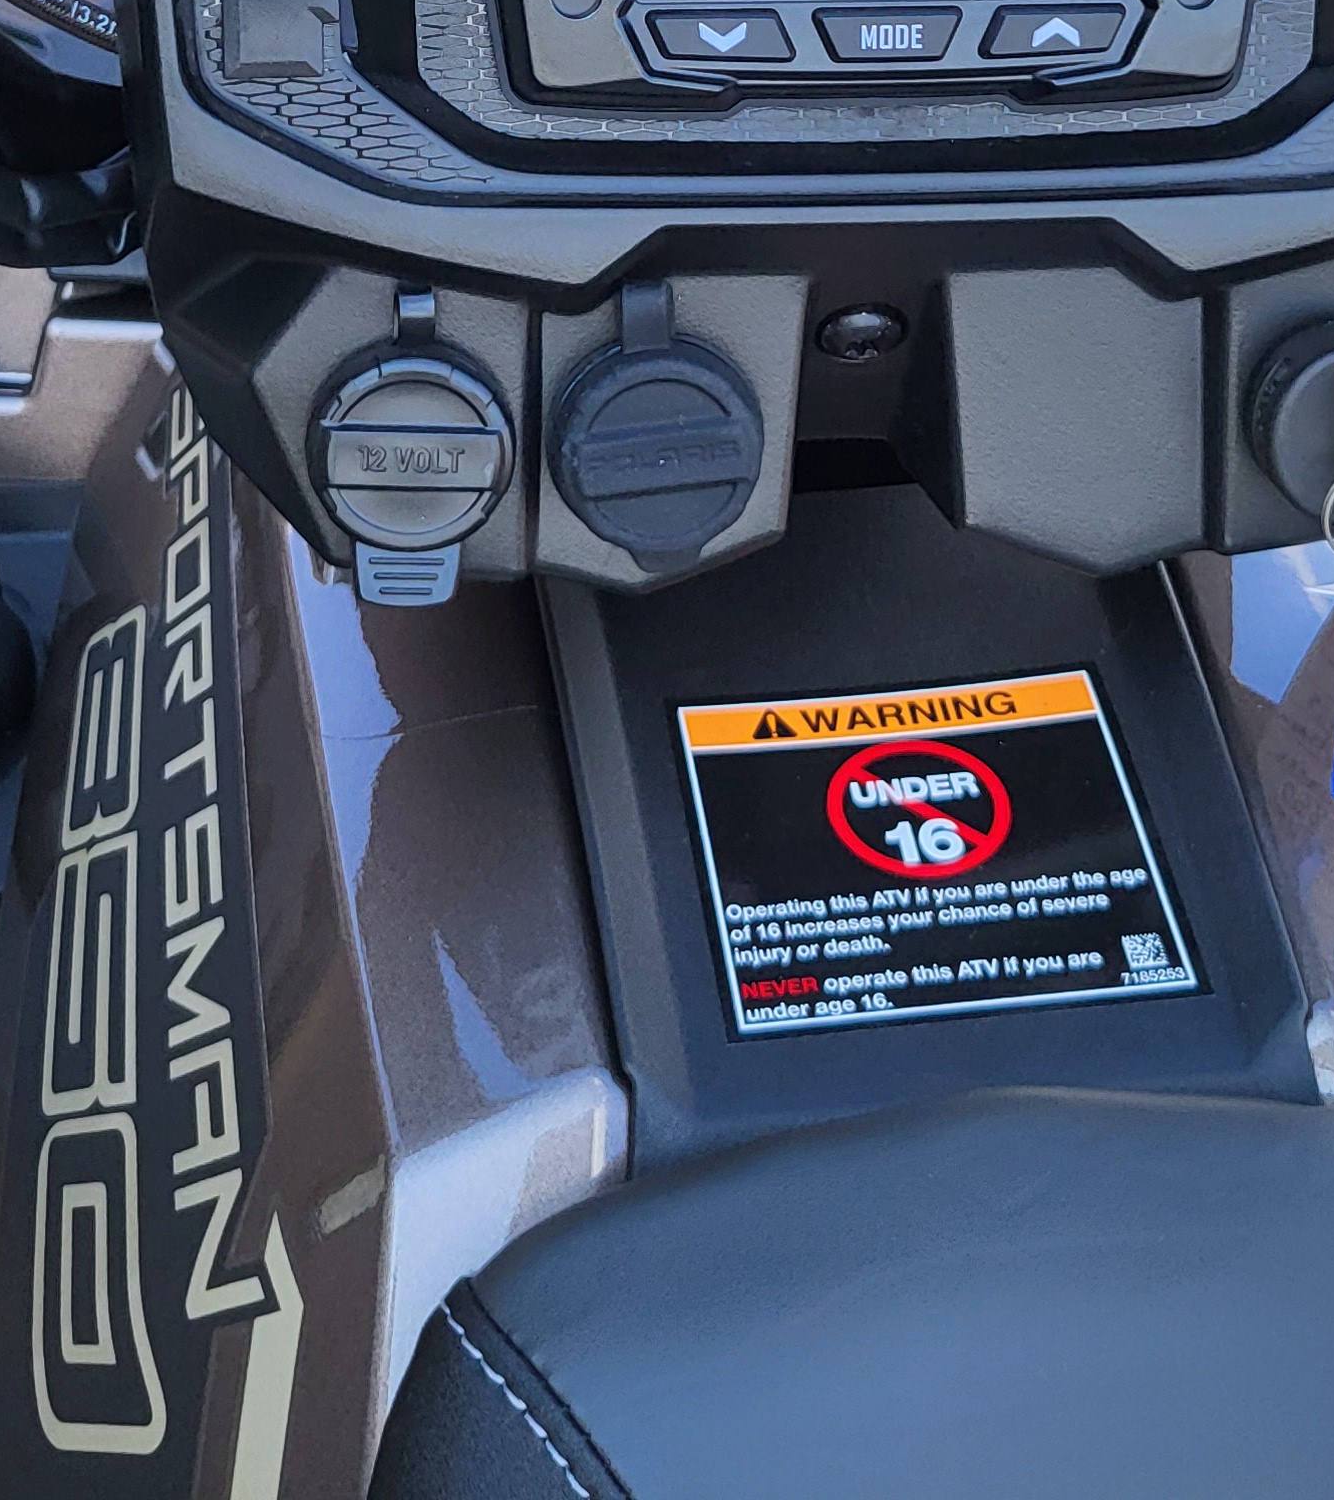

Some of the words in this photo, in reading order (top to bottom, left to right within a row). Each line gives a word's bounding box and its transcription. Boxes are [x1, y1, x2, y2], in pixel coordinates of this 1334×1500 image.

[861, 24, 924, 50] MODE
[357, 444, 387, 474] 12
[394, 446, 466, 475] VOLT
[799, 690, 1017, 733] WARNING
[849, 771, 981, 809] UNDER
[163, 387, 266, 1321] SPORTSMAN
[884, 817, 967, 867] 16
[725, 898, 827, 924] Operating
[829, 893, 869, 913] this
[872, 888, 911, 911] ATV
[914, 886, 930, 906] if
[932, 884, 971, 906] you
[974, 881, 1008, 901] are
[1010, 874, 1069, 897] under
[1072, 870, 1107, 891] the
[1109, 867, 1149, 891] age
[730, 924, 752, 945] of
[756, 921, 782, 944] 16
[784, 913, 886, 941] increases
[887, 909, 934, 935] your
[938, 901, 1014, 926] chance
[1016, 897, 1039, 918] of
[1041, 892, 1111, 917] severe
[734, 944, 792, 970] injury
[796, 942, 820, 962] or
[823, 934, 893, 961] death.
[741, 976, 819, 1000] NEVER
[823, 969, 909, 995] operate
[911, 963, 955, 986] this
[957, 957, 1000, 981] ATV
[1003, 956, 1020, 978] if
[1022, 953, 1065, 979] you
[1067, 950, 1105, 971] are
[745, 1002, 810, 1023] under
[814, 998, 857, 1020] age
[861, 991, 894, 1011] 16.
